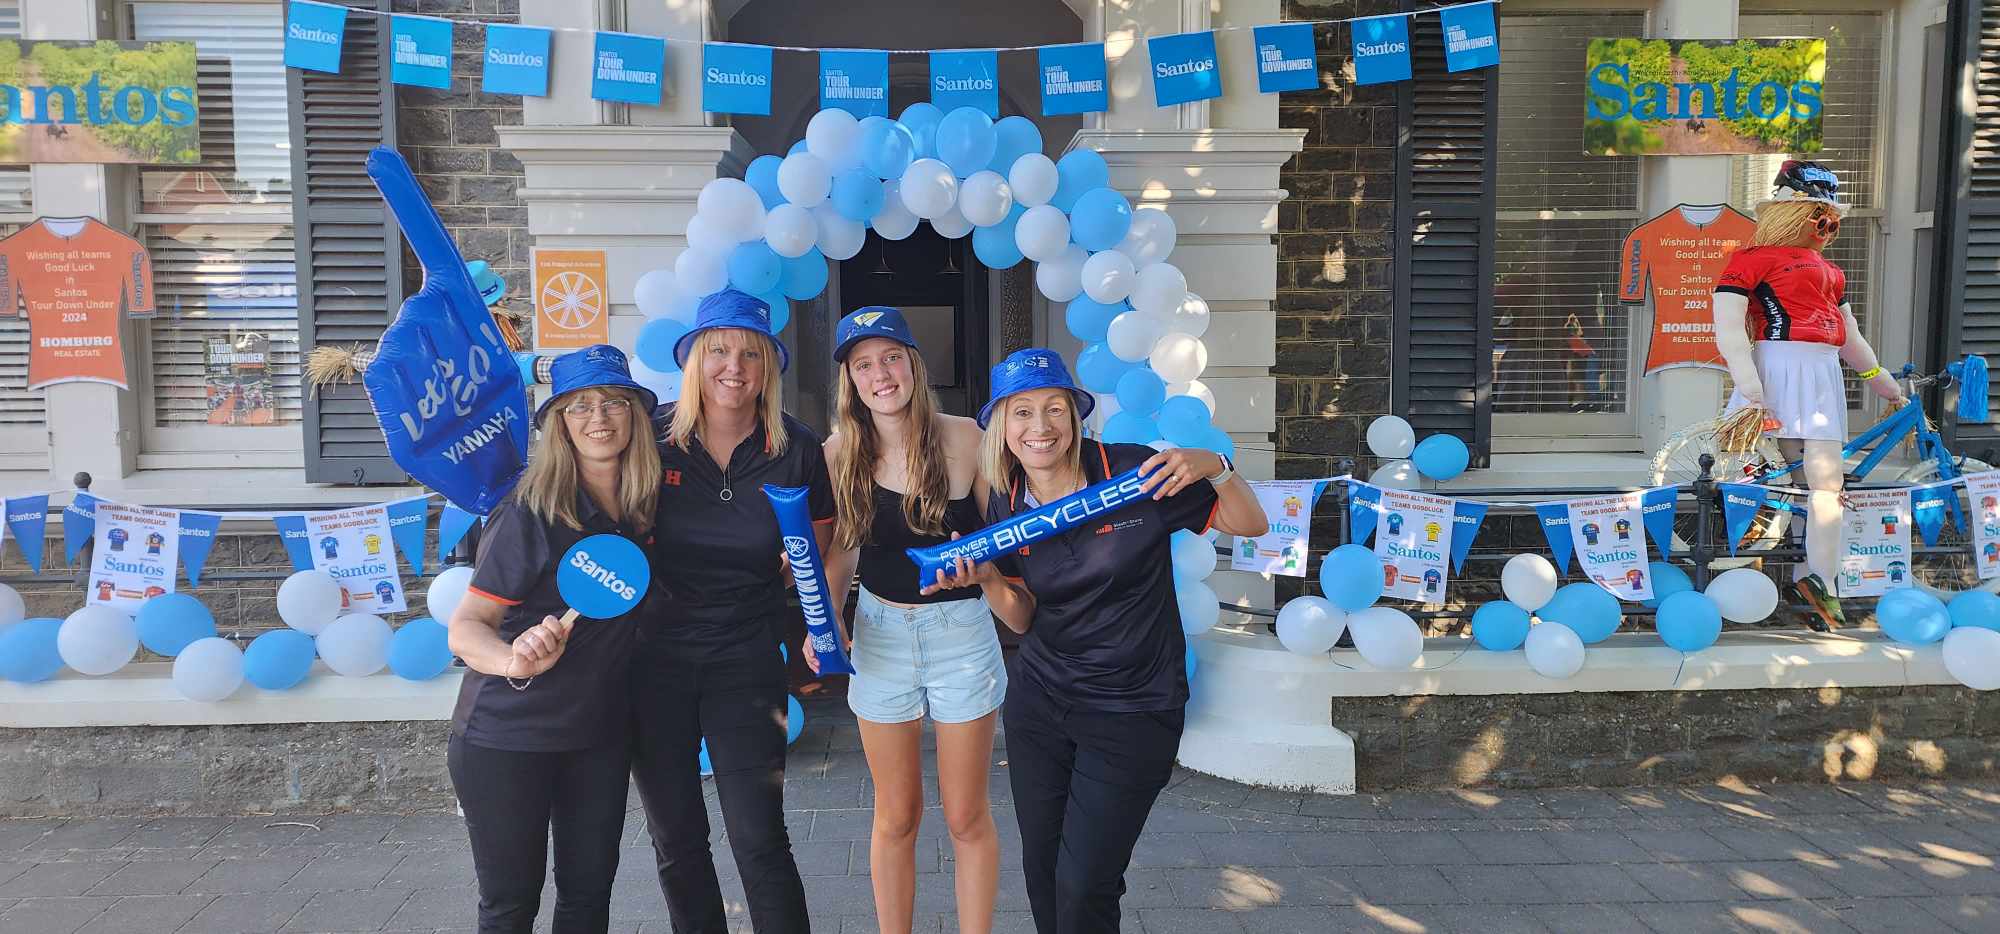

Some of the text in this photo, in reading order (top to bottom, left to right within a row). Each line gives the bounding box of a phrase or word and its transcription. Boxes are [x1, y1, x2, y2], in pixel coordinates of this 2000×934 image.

[288, 23, 338, 45] Santos
[1356, 40, 1406, 57] Santos
[488, 48, 544, 68] Santos
[599, 57, 624, 69] TOUR
[1156, 58, 1214, 79] Santos
[707, 67, 766, 86] Santos
[825, 75, 850, 87] TOUR
[1045, 71, 1069, 84] TOUR
[935, 76, 993, 91] Santos
[1587, 62, 1823, 122] Santos
[0, 70, 198, 128] antos
[1660, 238, 1741, 248] Wishing all teams
[26, 250, 111, 261] Wishing all teams
[1675, 250, 1724, 260] Good Luck
[45, 263, 95, 273] Good Luck
[1693, 262, 1702, 271] in
[65, 276, 75, 285] in
[1680, 274, 1713, 284] Santos
[54, 288, 88, 298] Santos
[1657, 287, 1677, 296] Tour
[1680, 287, 1707, 296] Down
[32, 300, 115, 310] Tour Down Under
[1684, 300, 1708, 310] 2024
[62, 312, 87, 323] 2024
[1661, 322, 1715, 334] HOMBU
[40, 336, 113, 348] HOMBURG
[442, 406, 519, 465] YAMAHA
[665, 469, 682, 486] H
[1727, 494, 1756, 507] Santos
[1915, 499, 1944, 510] Santos
[1642, 502, 1672, 514] Santos
[9, 511, 42, 522] Santos
[390, 513, 422, 527] Santos
[940, 477, 1144, 561] POWER BICYCLES
[1453, 515, 1477, 525] antos
[1545, 517, 1569, 526] Santo
[177, 527, 210, 538] Santos
[1267, 519, 1300, 535] ntos
[285, 529, 308, 539] Sant
[1387, 541, 1441, 562] Santos
[1849, 543, 1902, 556] Santos
[1587, 548, 1638, 565] Santos
[104, 556, 165, 577] Santos
[328, 562, 387, 580] Santos
[570, 550, 637, 600] Santos
[789, 556, 828, 626] YAMAHA
